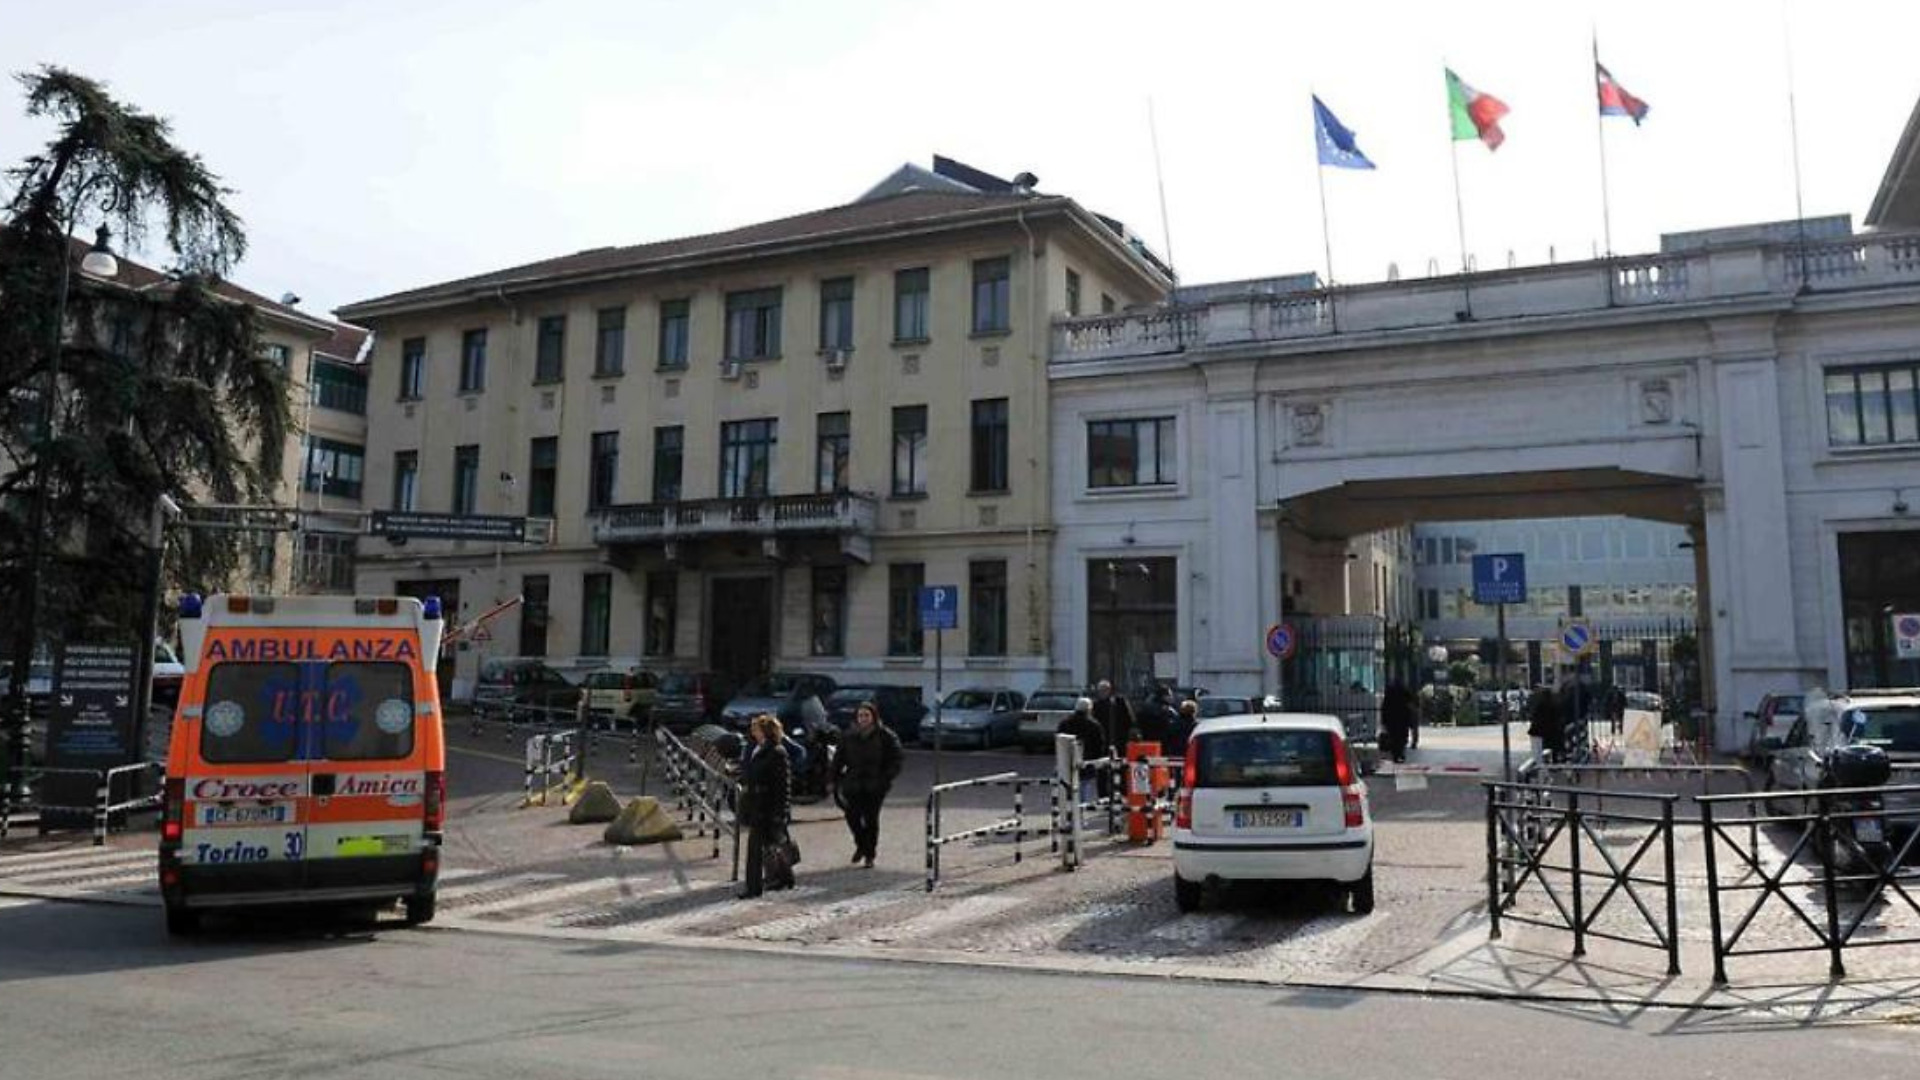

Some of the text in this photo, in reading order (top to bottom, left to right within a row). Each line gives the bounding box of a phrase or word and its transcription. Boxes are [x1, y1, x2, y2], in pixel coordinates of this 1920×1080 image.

[1492, 557, 1508, 581] P
[933, 589, 945, 609] P
[205, 639, 417, 660] AMBULANZA
[193, 775, 419, 799] Croce Amica
[197, 832, 302, 863] Torino 30
